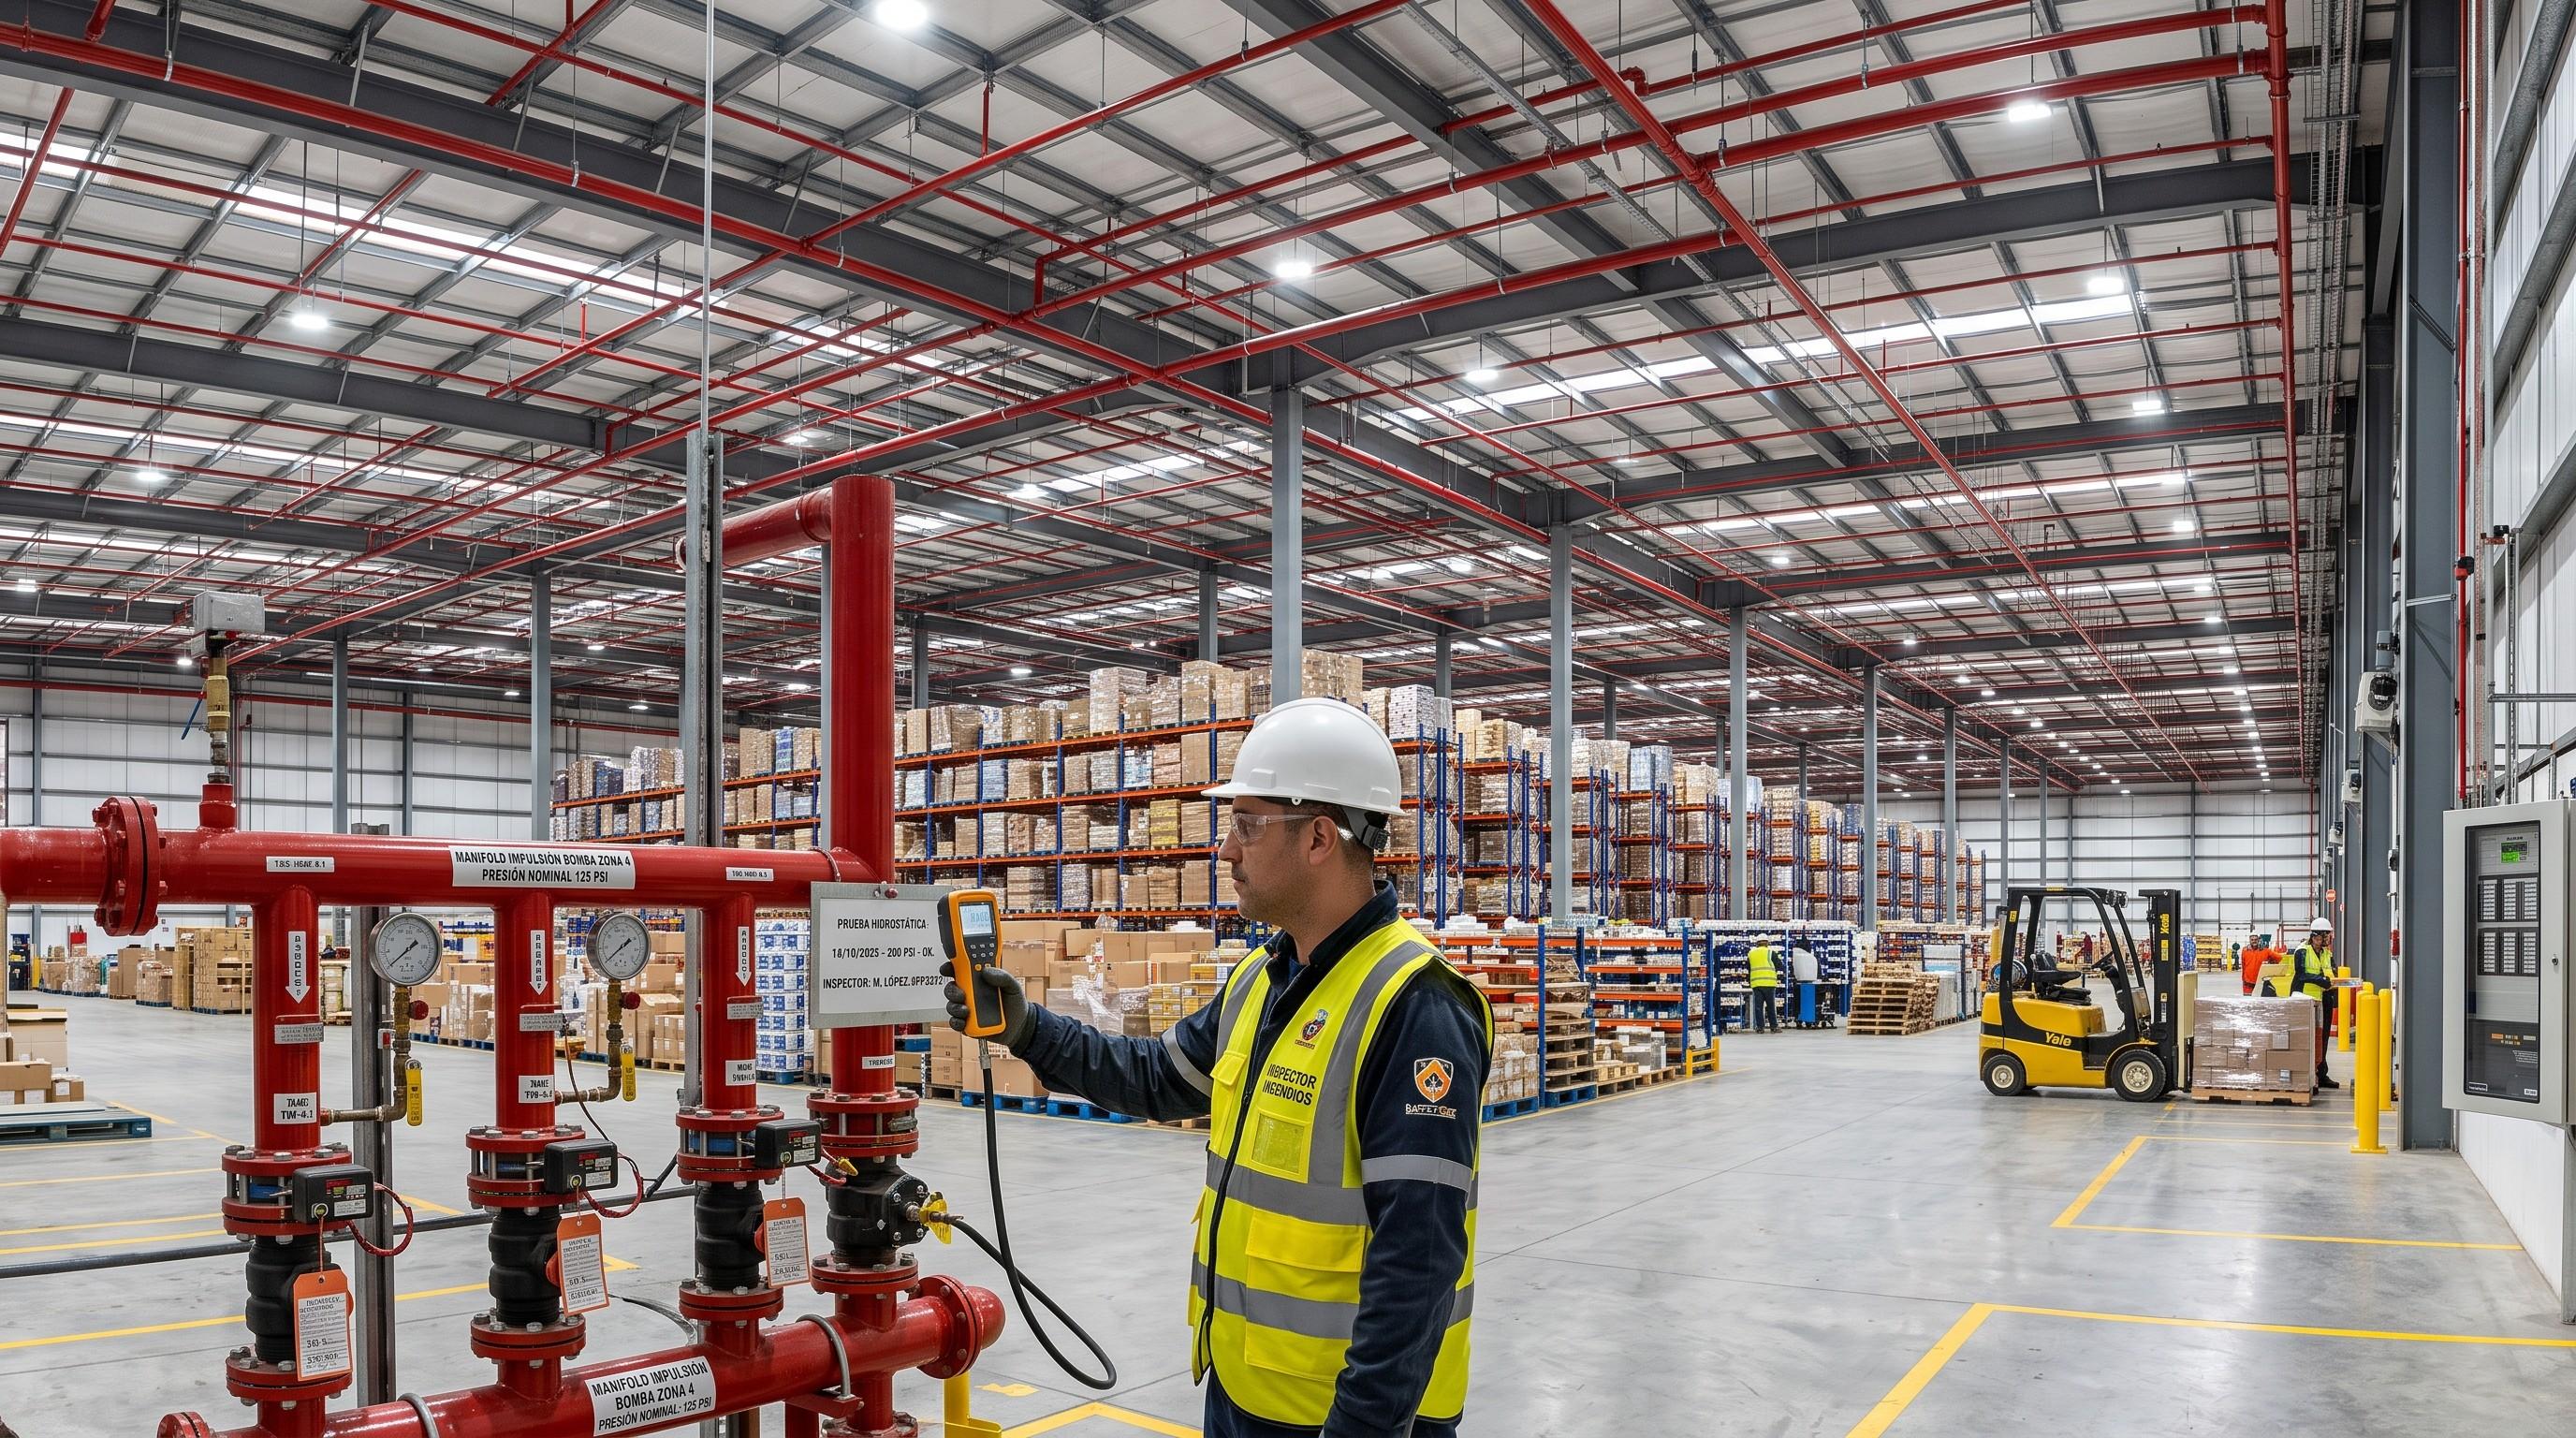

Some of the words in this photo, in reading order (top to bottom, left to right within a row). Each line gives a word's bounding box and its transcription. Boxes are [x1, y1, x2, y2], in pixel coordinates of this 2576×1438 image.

[455, 851, 506, 864] MANIFOLD
[508, 851, 562, 865] IMPULSIÓN
[564, 854, 596, 866] BOMBA
[598, 855, 623, 867] ZONA
[624, 856, 631, 867] 4
[482, 867, 526, 882] PRESIÓN
[528, 870, 572, 883] NOMINAL
[575, 871, 592, 883] 125
[593, 871, 608, 883] PSI
[837, 918, 870, 930] PRUEBA
[886, 947, 901, 958] 200
[903, 946, 915, 958] PSI
[823, 977, 871, 990] INSPECTOR:
[2045, 1032, 2072, 1047] Yale
[592, 1373, 650, 1397] MANIFOLD
[650, 1360, 709, 1385] IMPULSIÓN
[615, 1390, 655, 1411] BOMBA
[657, 1384, 686, 1402] ZONA
[688, 1382, 695, 1395] 4
[598, 1411, 638, 1431] PRESIÓN
[683, 1400, 696, 1412] 125
[698, 1396, 711, 1408] PSI
